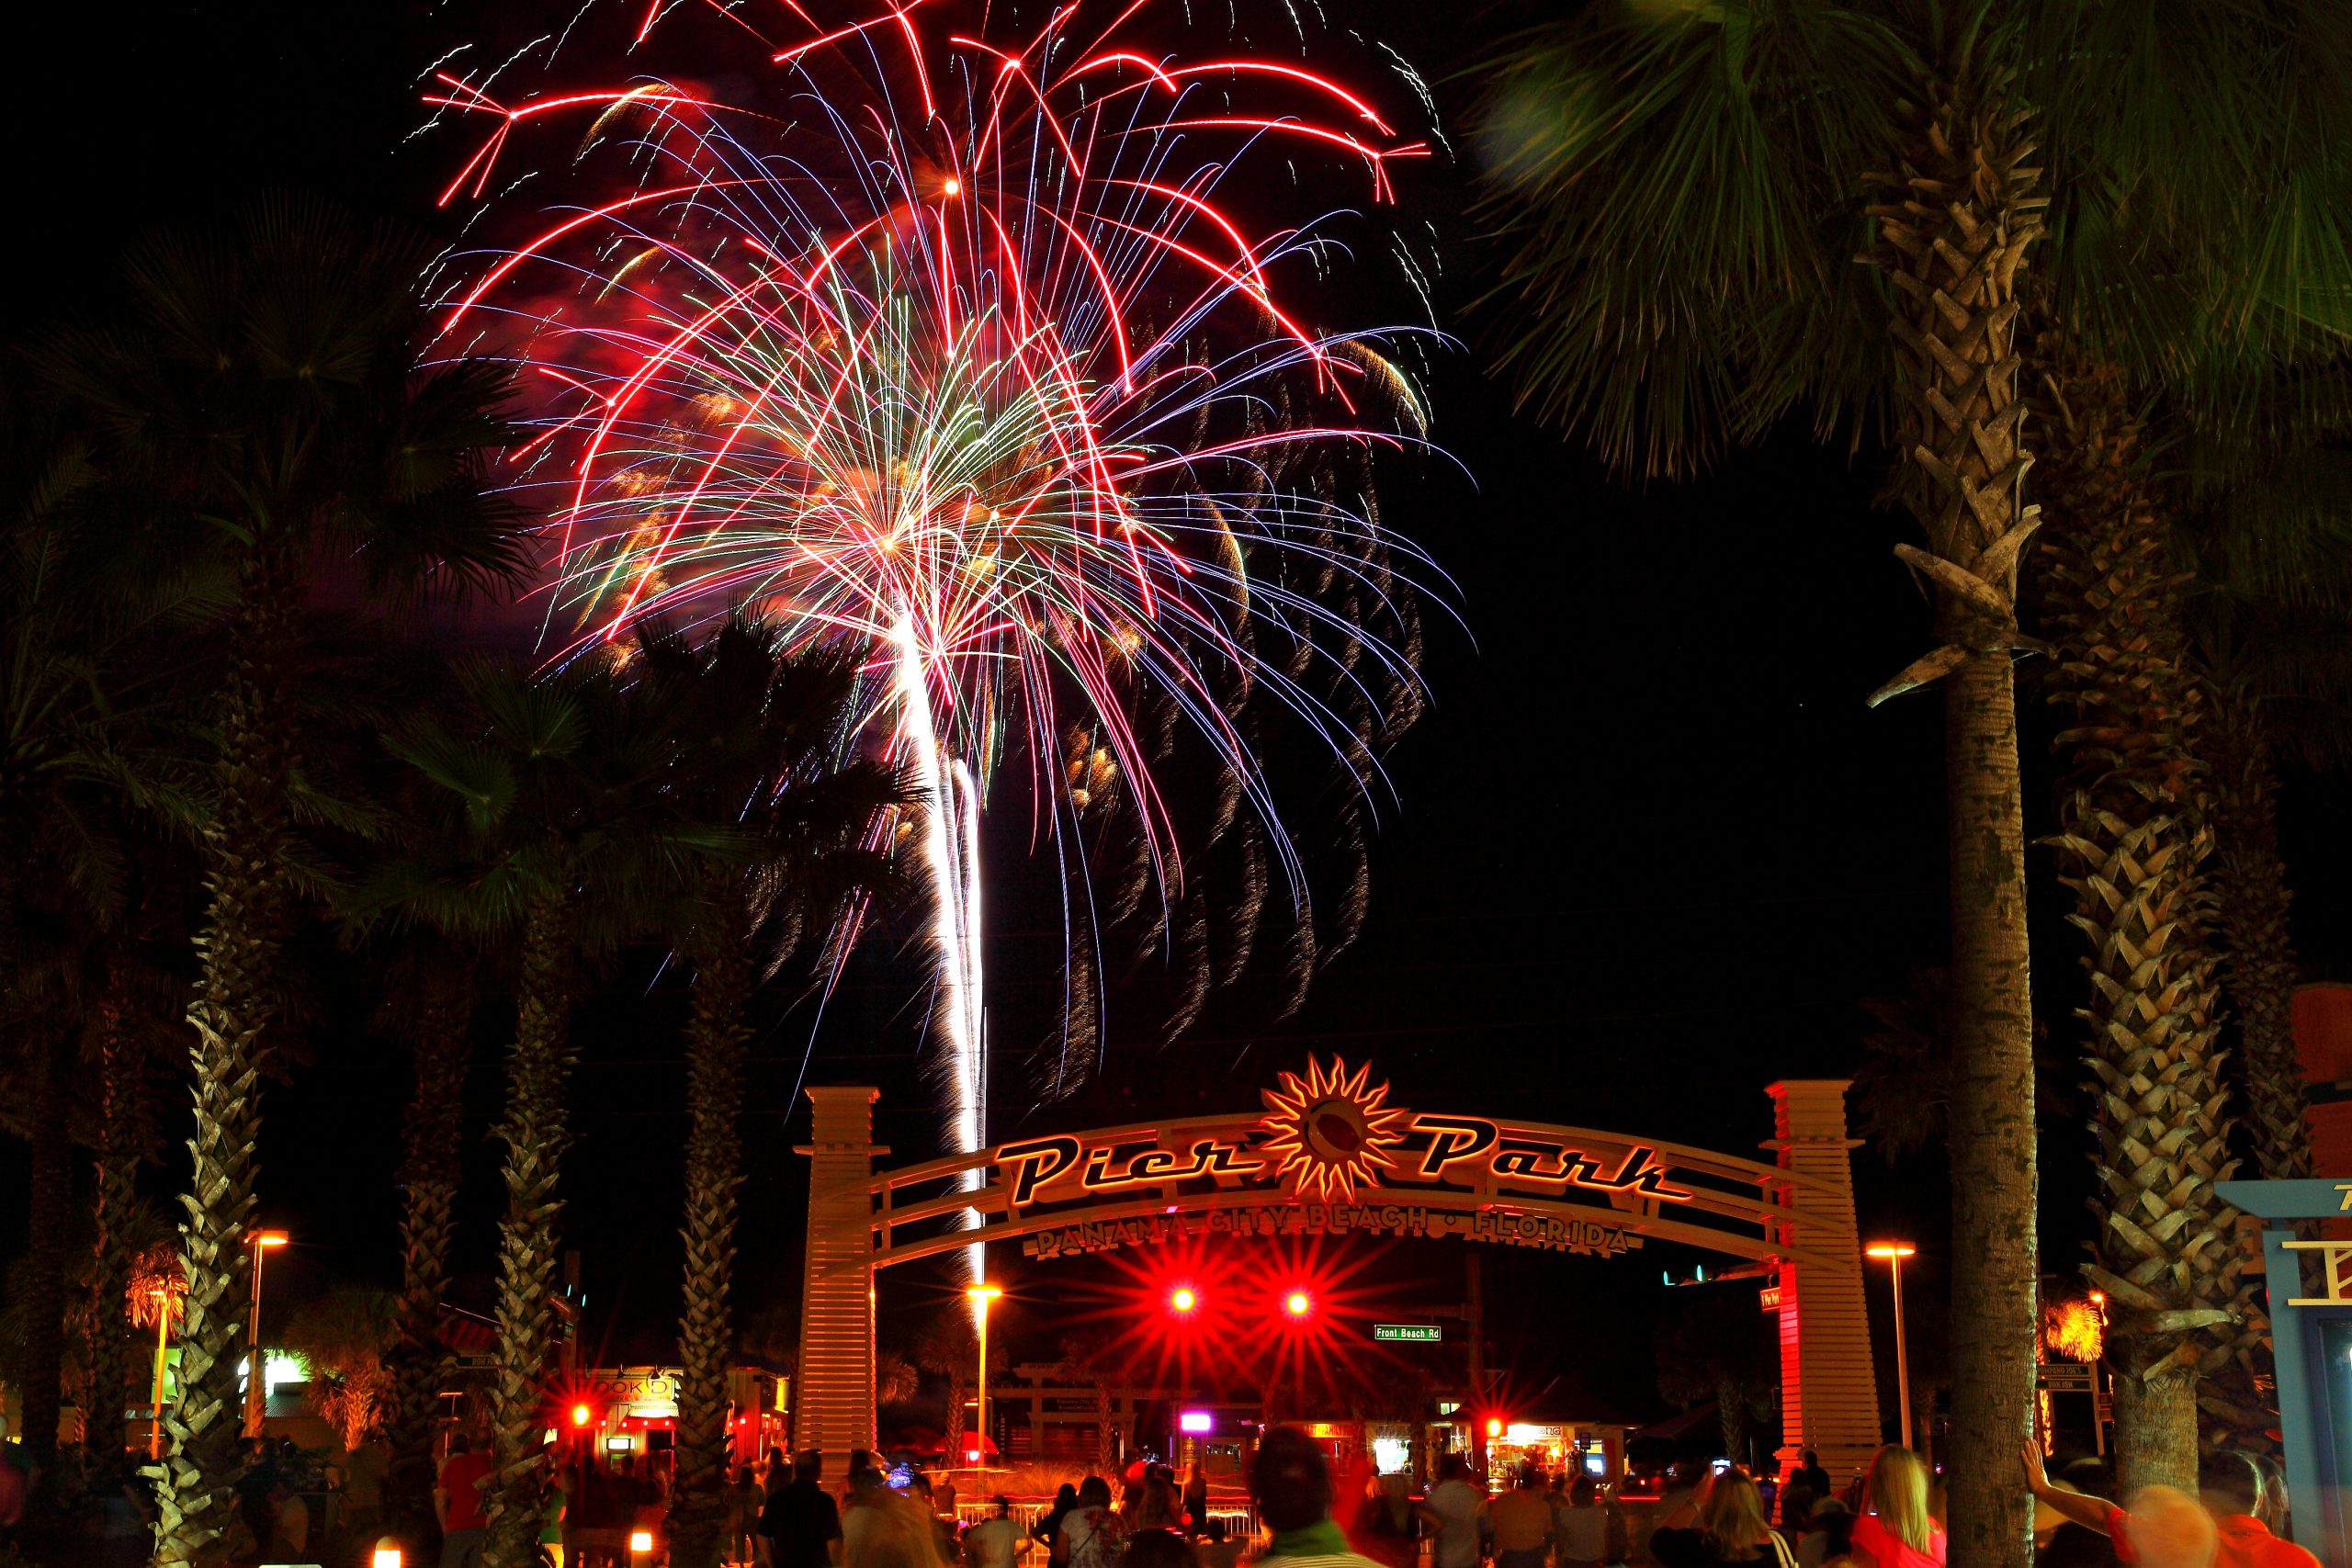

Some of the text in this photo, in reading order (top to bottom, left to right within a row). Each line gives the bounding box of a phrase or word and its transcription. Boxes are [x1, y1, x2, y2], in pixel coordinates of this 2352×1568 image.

[994, 1113, 1694, 1206] Pier Park
[1036, 1203, 1630, 1255] PANAMA CITY BEACH FLORIDA
[1377, 1327, 1439, 1338] Front Beach Rd
